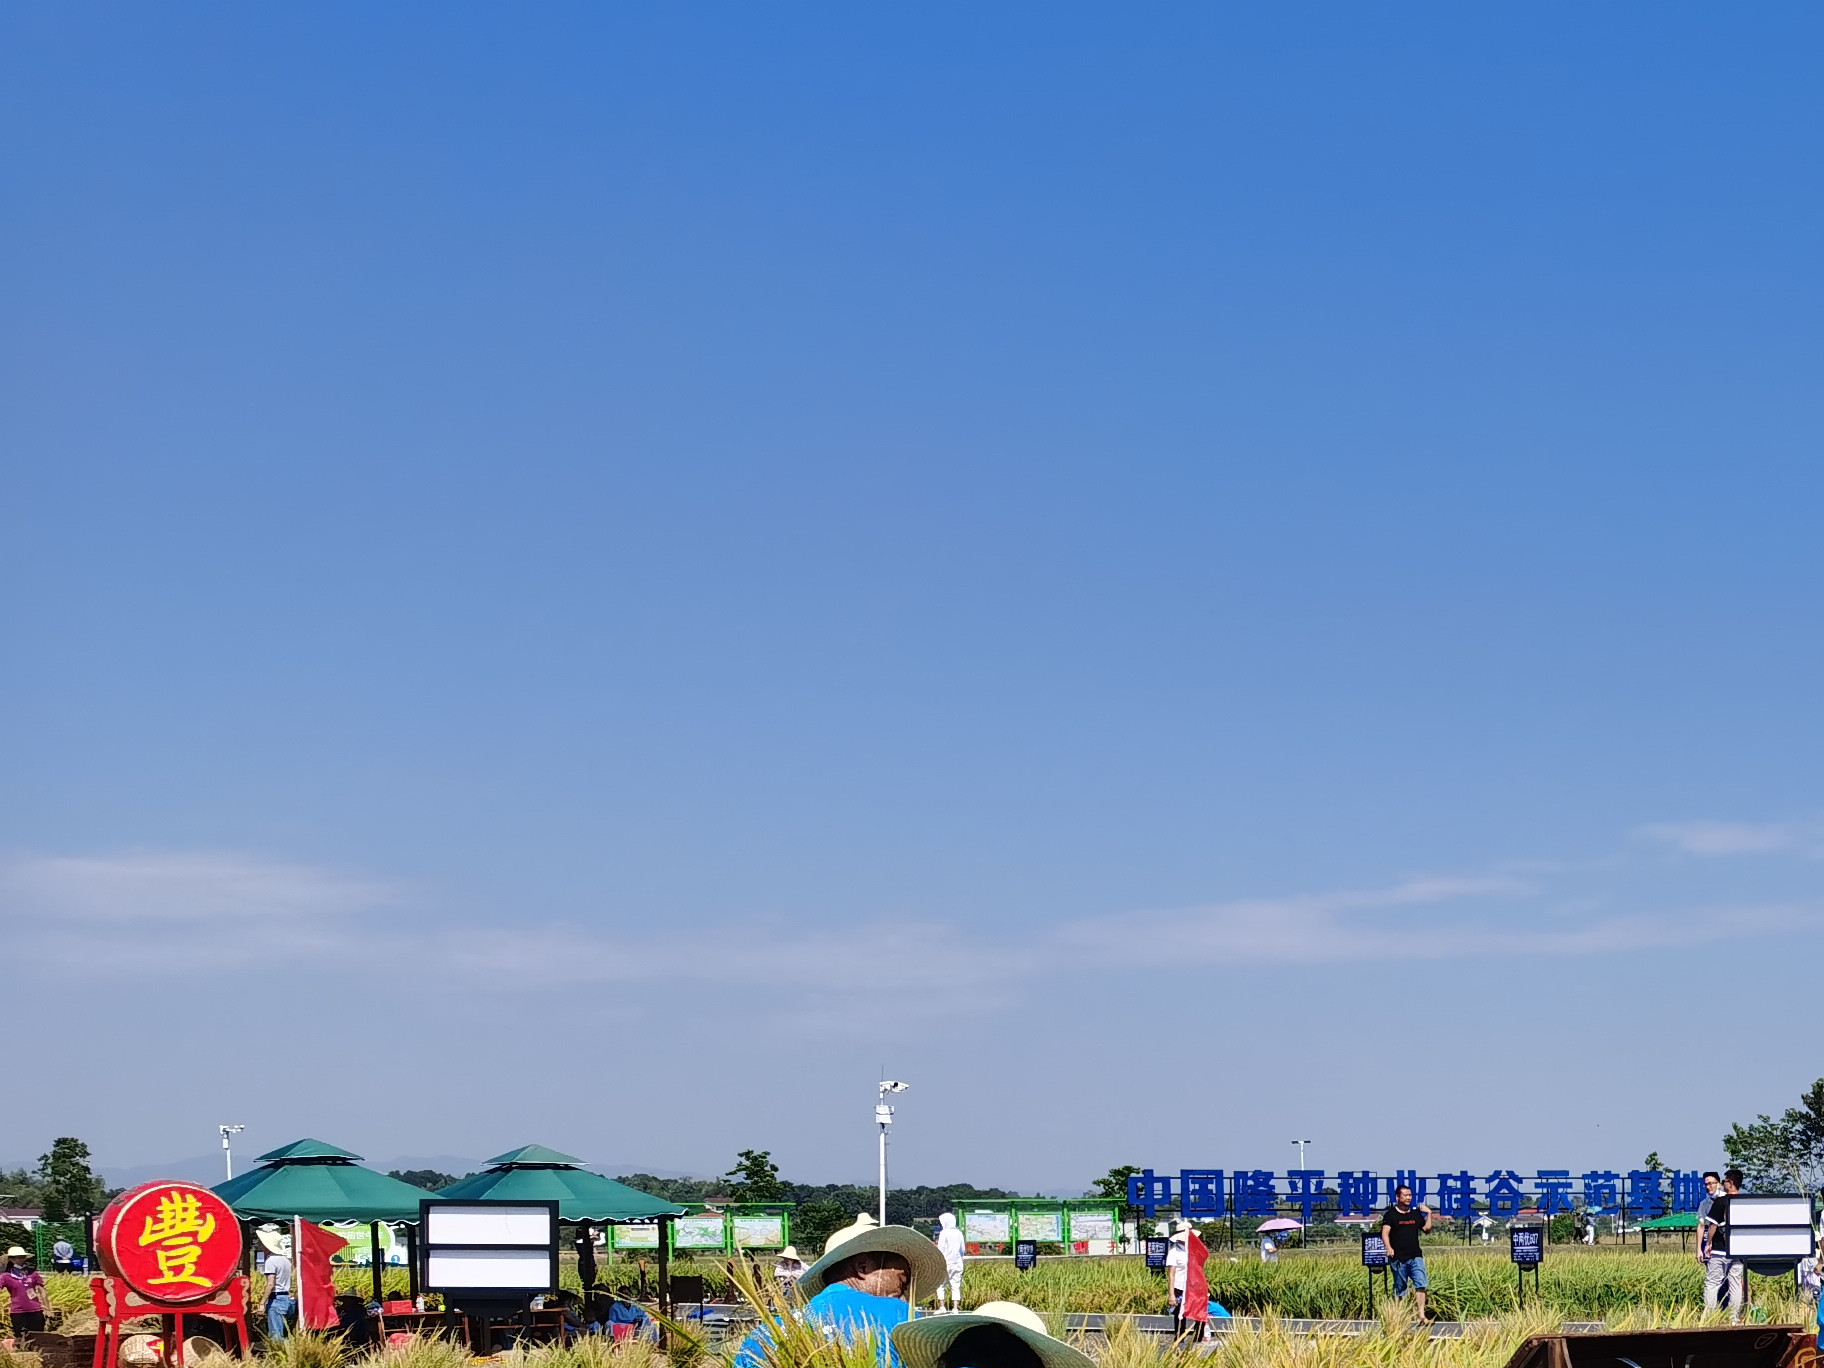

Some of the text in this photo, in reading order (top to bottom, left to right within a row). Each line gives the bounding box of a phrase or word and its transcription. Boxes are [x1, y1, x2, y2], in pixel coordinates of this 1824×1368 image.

[1127, 1168, 1706, 1219] 中国隆平种业硅谷示范基地
